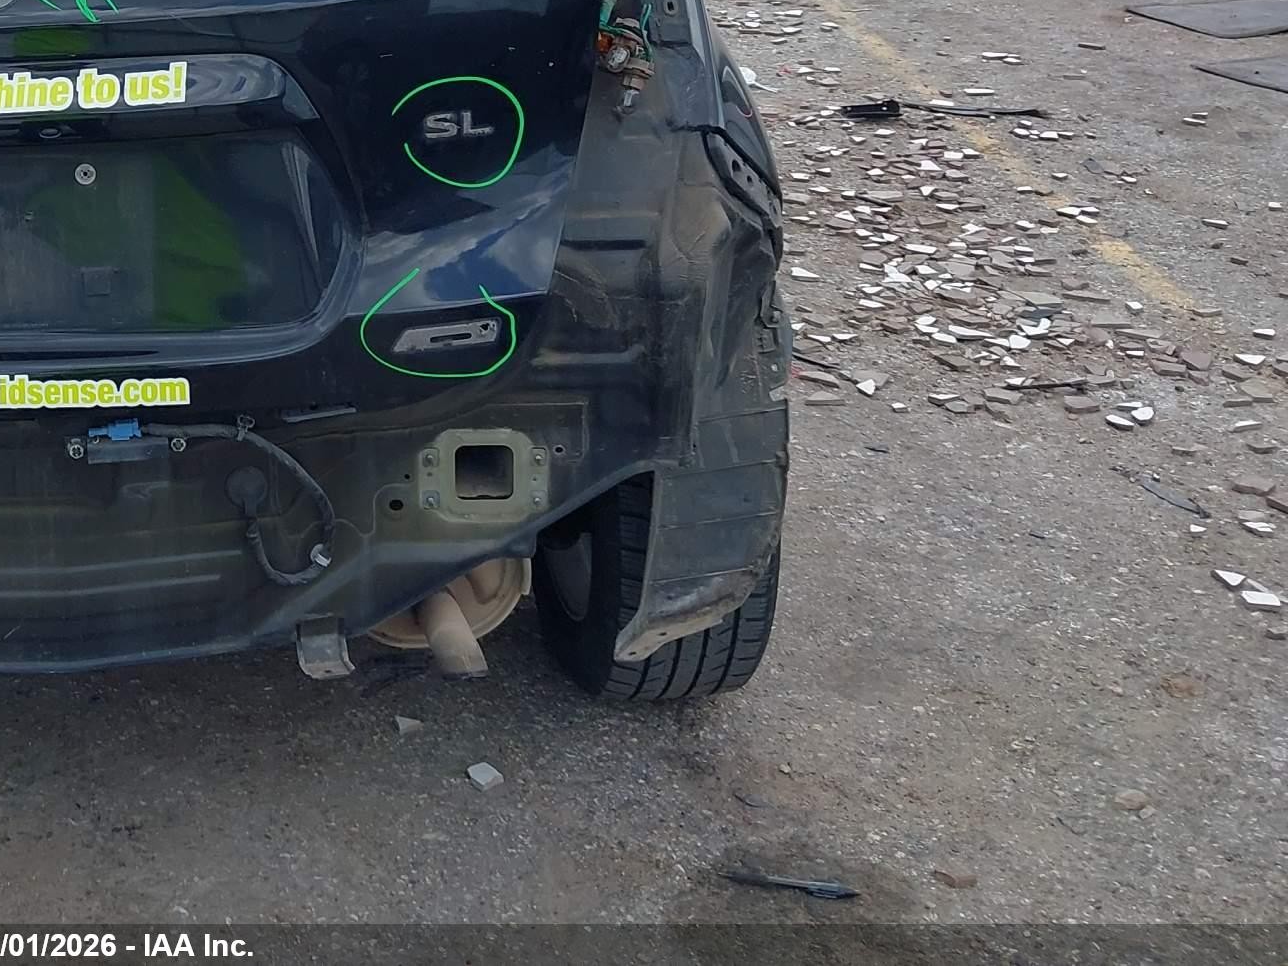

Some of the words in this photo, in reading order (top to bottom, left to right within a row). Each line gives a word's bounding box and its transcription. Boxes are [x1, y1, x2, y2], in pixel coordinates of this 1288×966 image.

[79, 71, 119, 106] to
[127, 64, 185, 104] us!
[423, 111, 495, 139] SL
